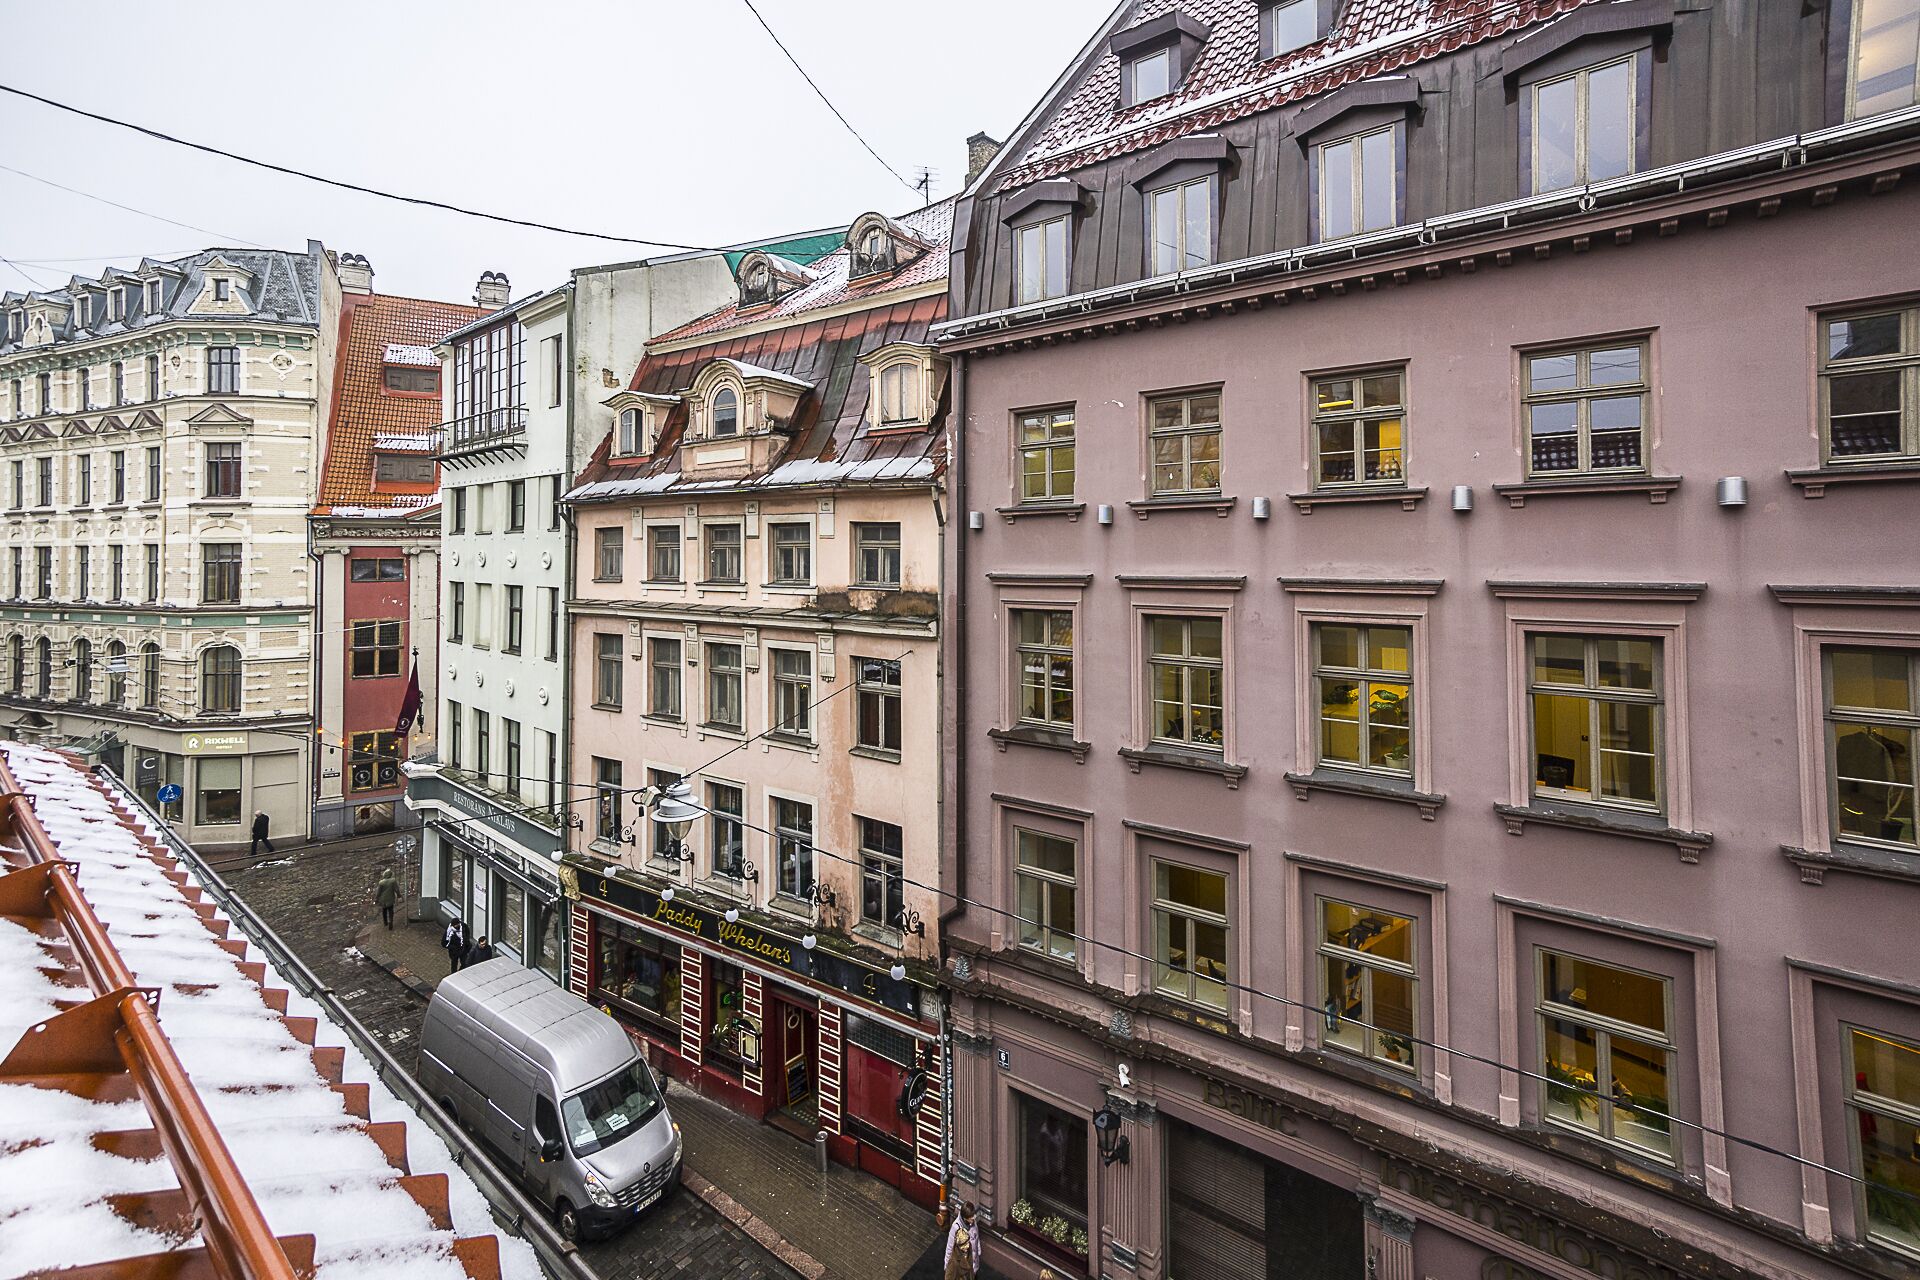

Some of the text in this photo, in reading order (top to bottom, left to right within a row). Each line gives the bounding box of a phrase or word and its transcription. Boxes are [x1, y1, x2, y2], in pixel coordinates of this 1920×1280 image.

[204, 736, 246, 745] RIXWELL
[599, 879, 877, 996] 4 Paddy Whelan's 4
[1000, 1052, 1006, 1061] 6
[1201, 1078, 1673, 1280] Baltic Internation
